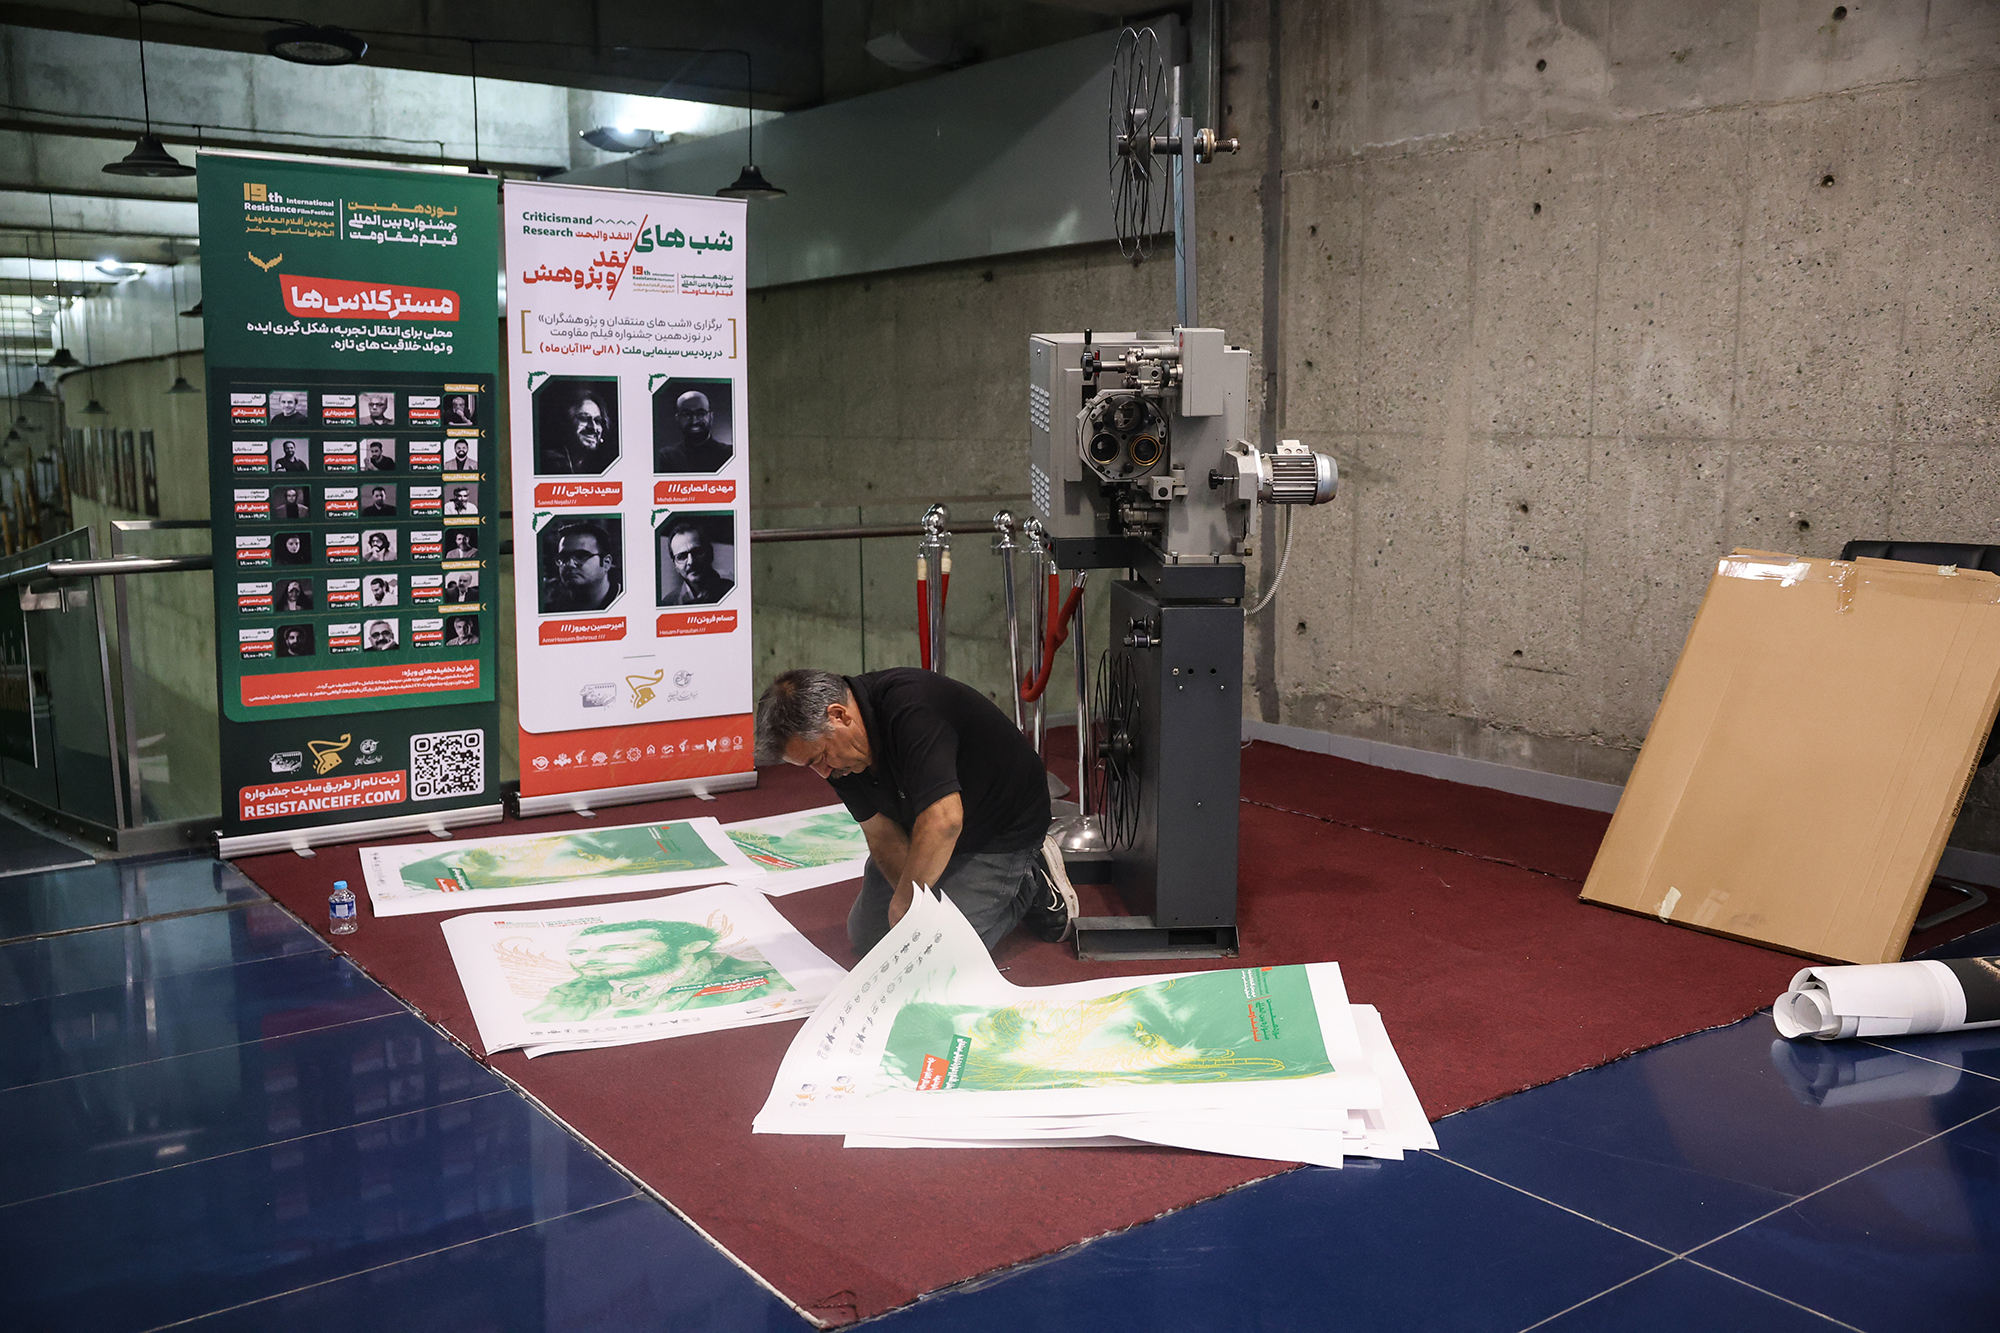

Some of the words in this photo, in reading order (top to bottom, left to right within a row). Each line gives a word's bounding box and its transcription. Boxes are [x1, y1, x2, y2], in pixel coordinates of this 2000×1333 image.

[244, 202, 296, 214] Resistance
[286, 198, 334, 207] International
[382, 218, 402, 230] بین
[522, 211, 571, 223] Criticism
[572, 215, 592, 225] and
[403, 218, 458, 232] جشنواره
[523, 225, 573, 237] Research
[350, 230, 418, 244] مقاومت
[420, 232, 458, 247] فیلم
[634, 224, 685, 254] های
[689, 230, 733, 255] شب
[593, 250, 629, 268] نقد
[523, 264, 602, 290] پژوهش
[246, 321, 272, 334] ایده
[600, 319, 605, 327] و
[606, 316, 645, 326] منتقدان
[647, 318, 666, 328] های
[694, 318, 722, 331] برگزاری
[273, 320, 300, 336] گیری
[301, 322, 329, 335] شکل
[368, 325, 400, 338] انتقال
[401, 326, 422, 340] برای
[424, 328, 453, 340] محلی
[550, 328, 588, 340] مقاومت
[590, 328, 614, 340] فیلم
[614, 329, 652, 341] جشنواره
[655, 332, 701, 343] نوزدهمین
[702, 334, 712, 343] در
[356, 339, 380, 352] های
[381, 339, 422, 353] خلاقیت
[422, 341, 445, 354] تولد
[446, 344, 453, 354] و
[561, 342, 579, 356] آبان
[622, 346, 642, 354] ملت
[643, 346, 680, 358] سینمایی
[680, 349, 712, 360] پردیس
[713, 351, 722, 359] در
[566, 486, 594, 498] نجاتی
[594, 486, 620, 498] سعید
[680, 484, 708, 494] انصاری
[708, 485, 734, 494] مهدی
[322, 779, 352, 793] طریق
[352, 778, 361, 790] از
[362, 777, 380, 790] نام
[380, 773, 400, 786] ثبت
[244, 786, 290, 802] جشنواره
[292, 784, 322, 797] سایت
[244, 789, 400, 818] RESISTANCEIFF.COM
